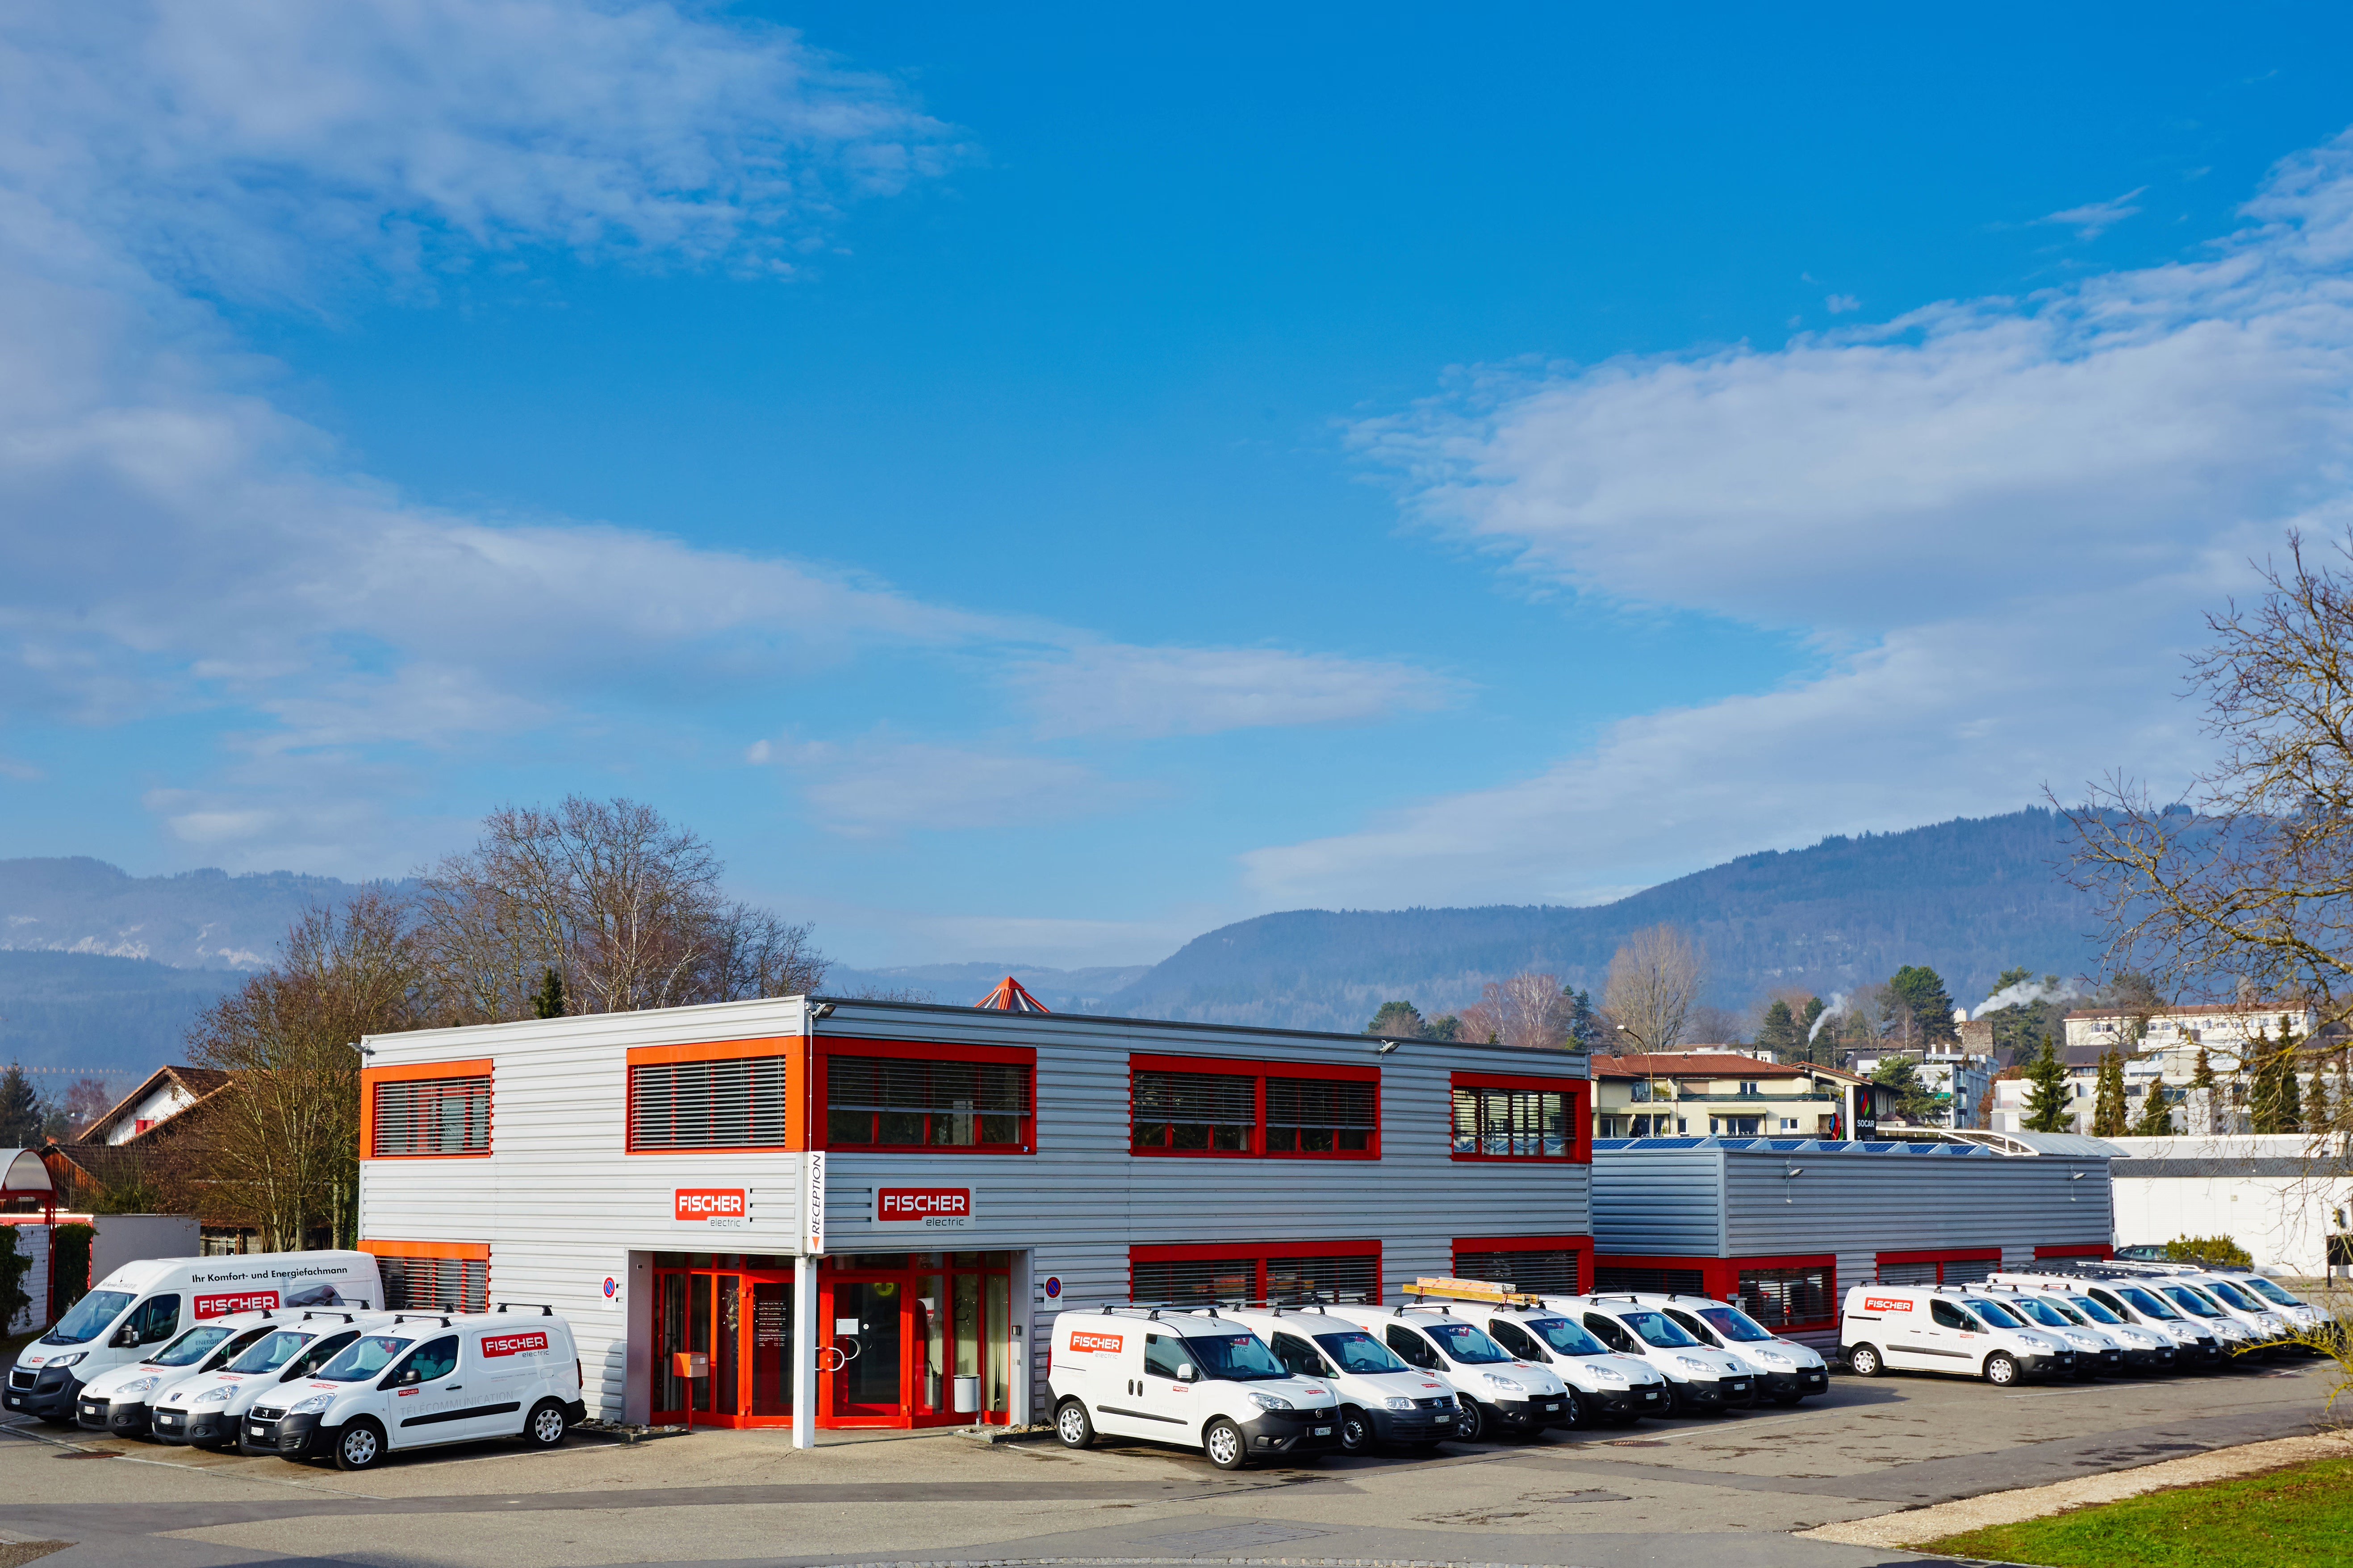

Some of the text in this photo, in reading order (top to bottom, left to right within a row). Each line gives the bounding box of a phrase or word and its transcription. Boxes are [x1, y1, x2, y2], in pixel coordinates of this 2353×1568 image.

[1857, 1119, 1875, 1127] SOCAR
[812, 1154, 821, 1234] RECEPTION
[679, 1195, 741, 1212] FISCHER
[884, 1195, 965, 1211] FISCHER
[710, 1218, 741, 1227] electric
[926, 1217, 964, 1226] electric
[192, 1267, 347, 1283] Ihr Komfort- und Energiefachmann
[199, 1296, 275, 1313] FISCHER
[1867, 1300, 1911, 1310] FISCHER
[485, 1336, 544, 1352] FISCHER
[1073, 1335, 1120, 1350] FISCHER
[400, 1391, 513, 1417] TÉLÉCOMMUNICATION
